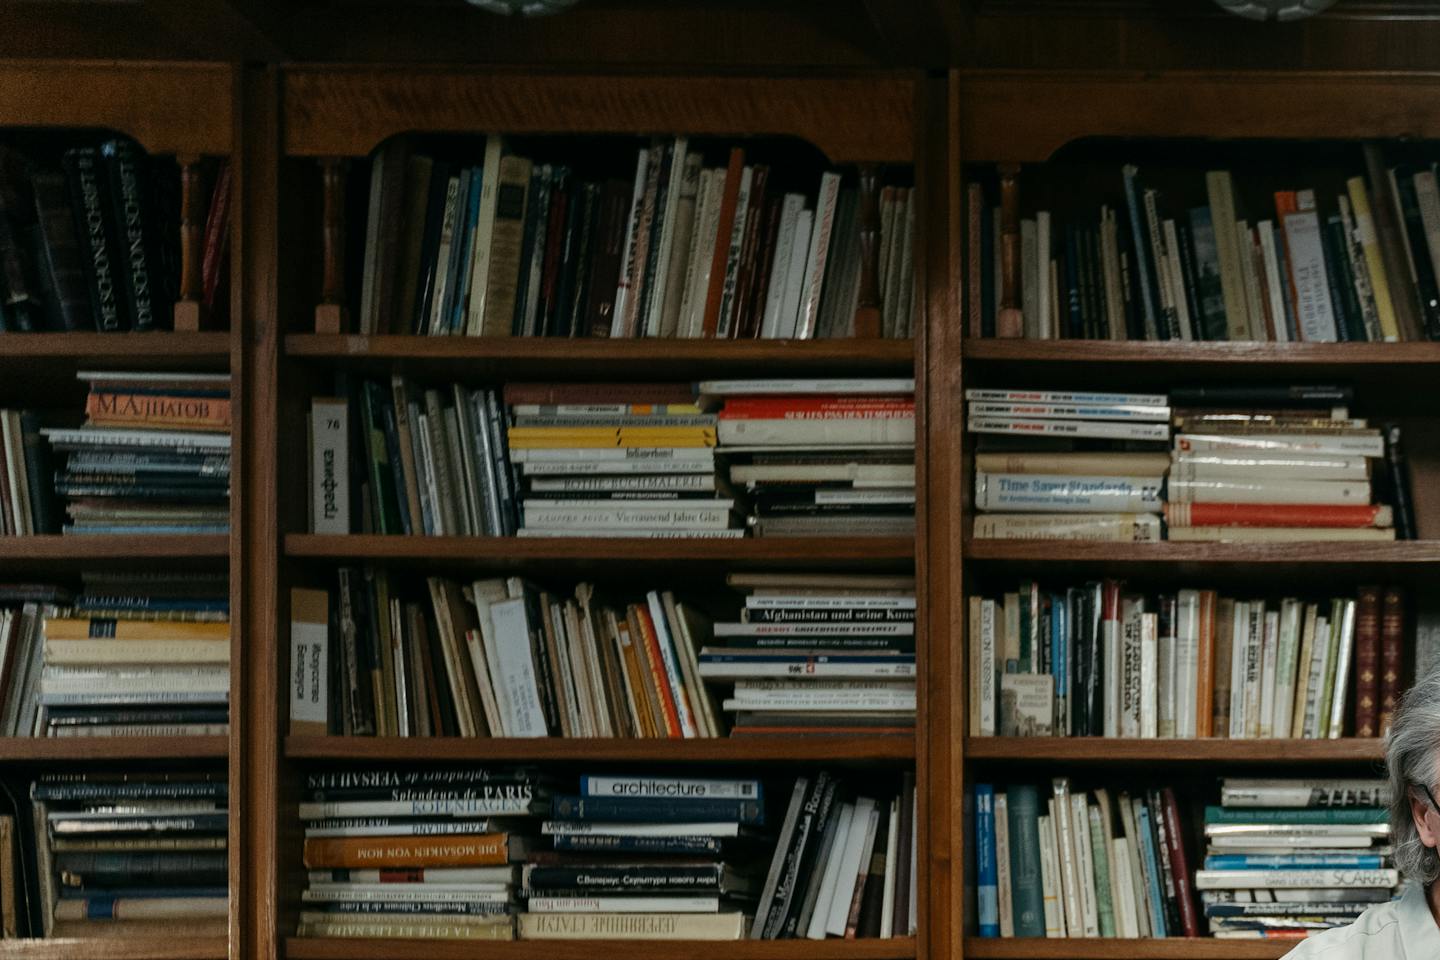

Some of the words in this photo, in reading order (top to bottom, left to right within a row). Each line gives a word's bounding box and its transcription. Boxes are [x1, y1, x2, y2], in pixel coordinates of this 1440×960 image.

[320, 448, 338, 519] графика
[1000, 480, 1029, 491] Time
[762, 609, 829, 622] Afghanistan
[831, 609, 853, 620] und
[855, 611, 884, 620] seine
[1124, 642, 1132, 711] AMERICA
[308, 771, 399, 788] VERSAILLES
[405, 772, 418, 785] de
[392, 789, 459, 801] Splendeurs
[464, 789, 476, 800] de
[484, 785, 533, 799] PARIS
[612, 780, 706, 796] architecture
[412, 800, 522, 814] KOPENHAGEN
[358, 848, 382, 858] ROM
[387, 848, 410, 857] VON
[414, 846, 475, 857] MOSAIKEN
[477, 844, 497, 855] DIE
[1332, 871, 1391, 885] SCARPA
